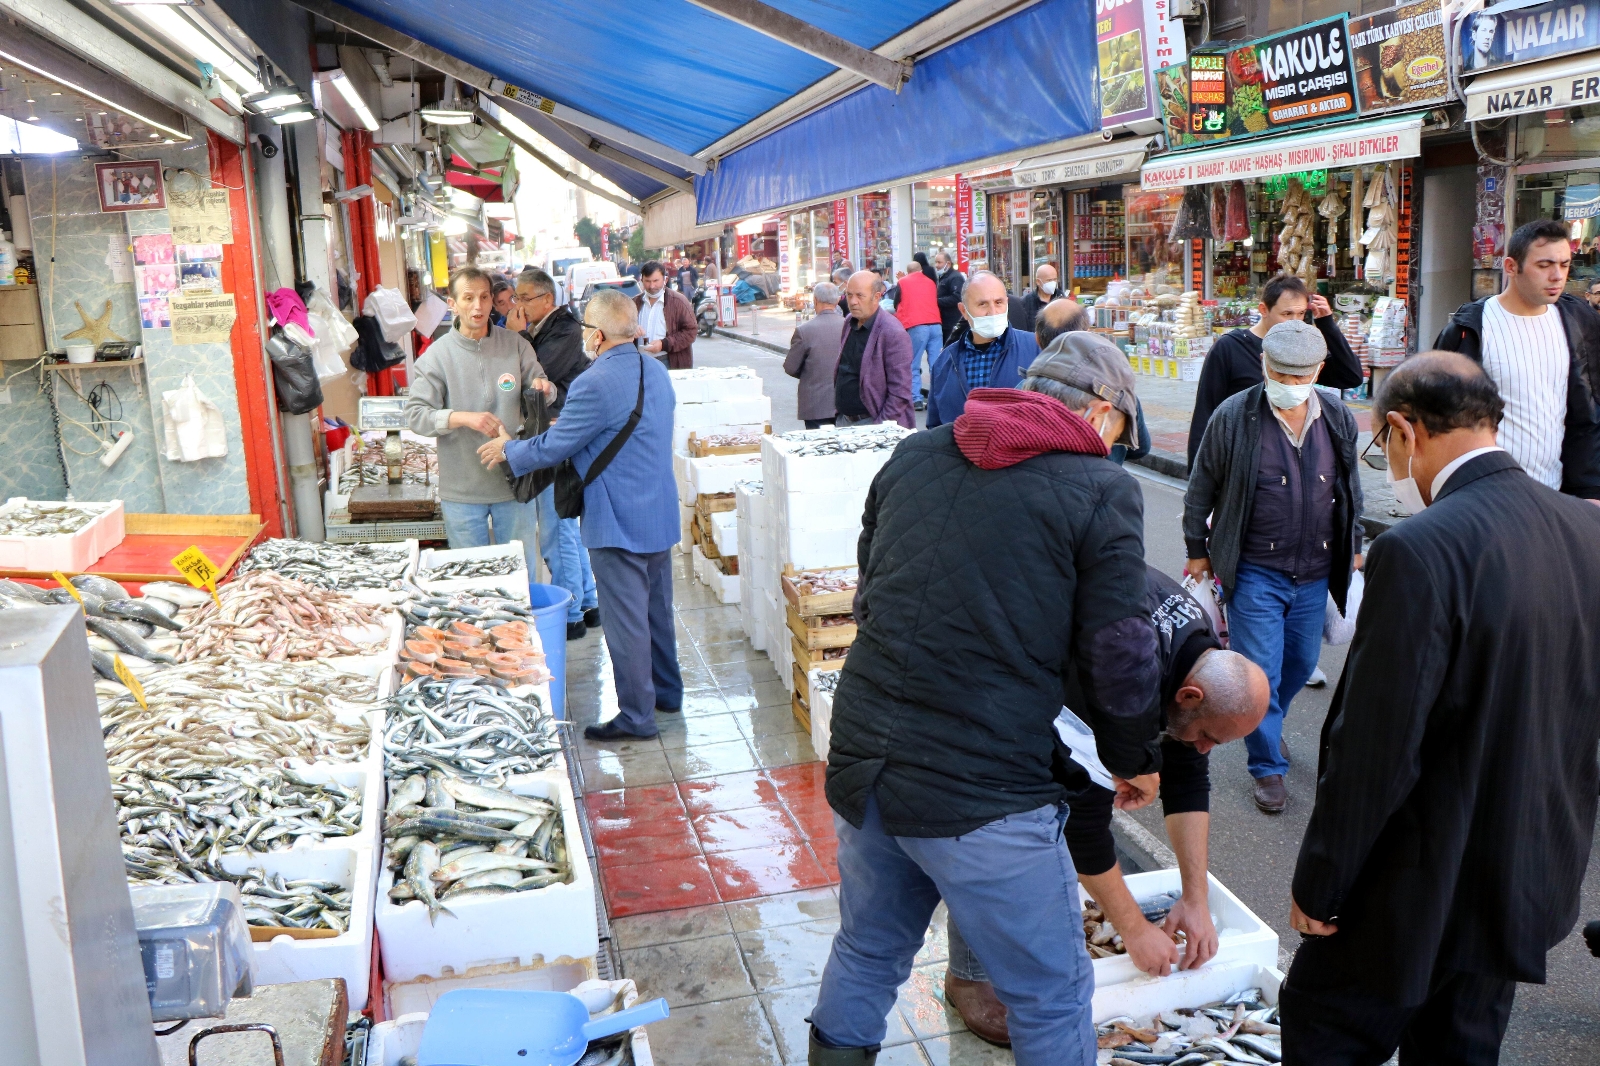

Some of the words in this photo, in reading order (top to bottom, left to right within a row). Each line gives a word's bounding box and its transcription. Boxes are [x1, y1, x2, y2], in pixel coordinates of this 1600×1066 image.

[1350, 31, 1366, 49] TAZE
[1367, 26, 1387, 47] TÜRK
[1385, 14, 1415, 41] KAHVESİ
[1505, 4, 1586, 55] NAZAR
[1191, 57, 1224, 70] KAKULE
[1260, 28, 1344, 83] KAKULE
[1191, 71, 1224, 81] BAHARAT
[1265, 87, 1297, 101] MISIR
[1299, 71, 1348, 96] ÇARŞISI
[1273, 105, 1308, 121] BAHARAT
[1310, 102, 1318, 113] &
[1319, 97, 1347, 111] AKTAR
[1487, 85, 1553, 114] NAZAR
[1145, 167, 1186, 183] KAKULE
[1197, 162, 1225, 178] BAHARAT
[1230, 157, 1252, 173] KAHVE
[1255, 151, 1283, 172] HAŞHAŞ
[1288, 148, 1326, 166] MISIRUNU
[1332, 142, 1357, 164] ŞİFALI
[1359, 135, 1399, 157] BİTKİLER
[172, 302, 204, 314] Tezgahlar
[205, 299, 234, 312] şenlendi
